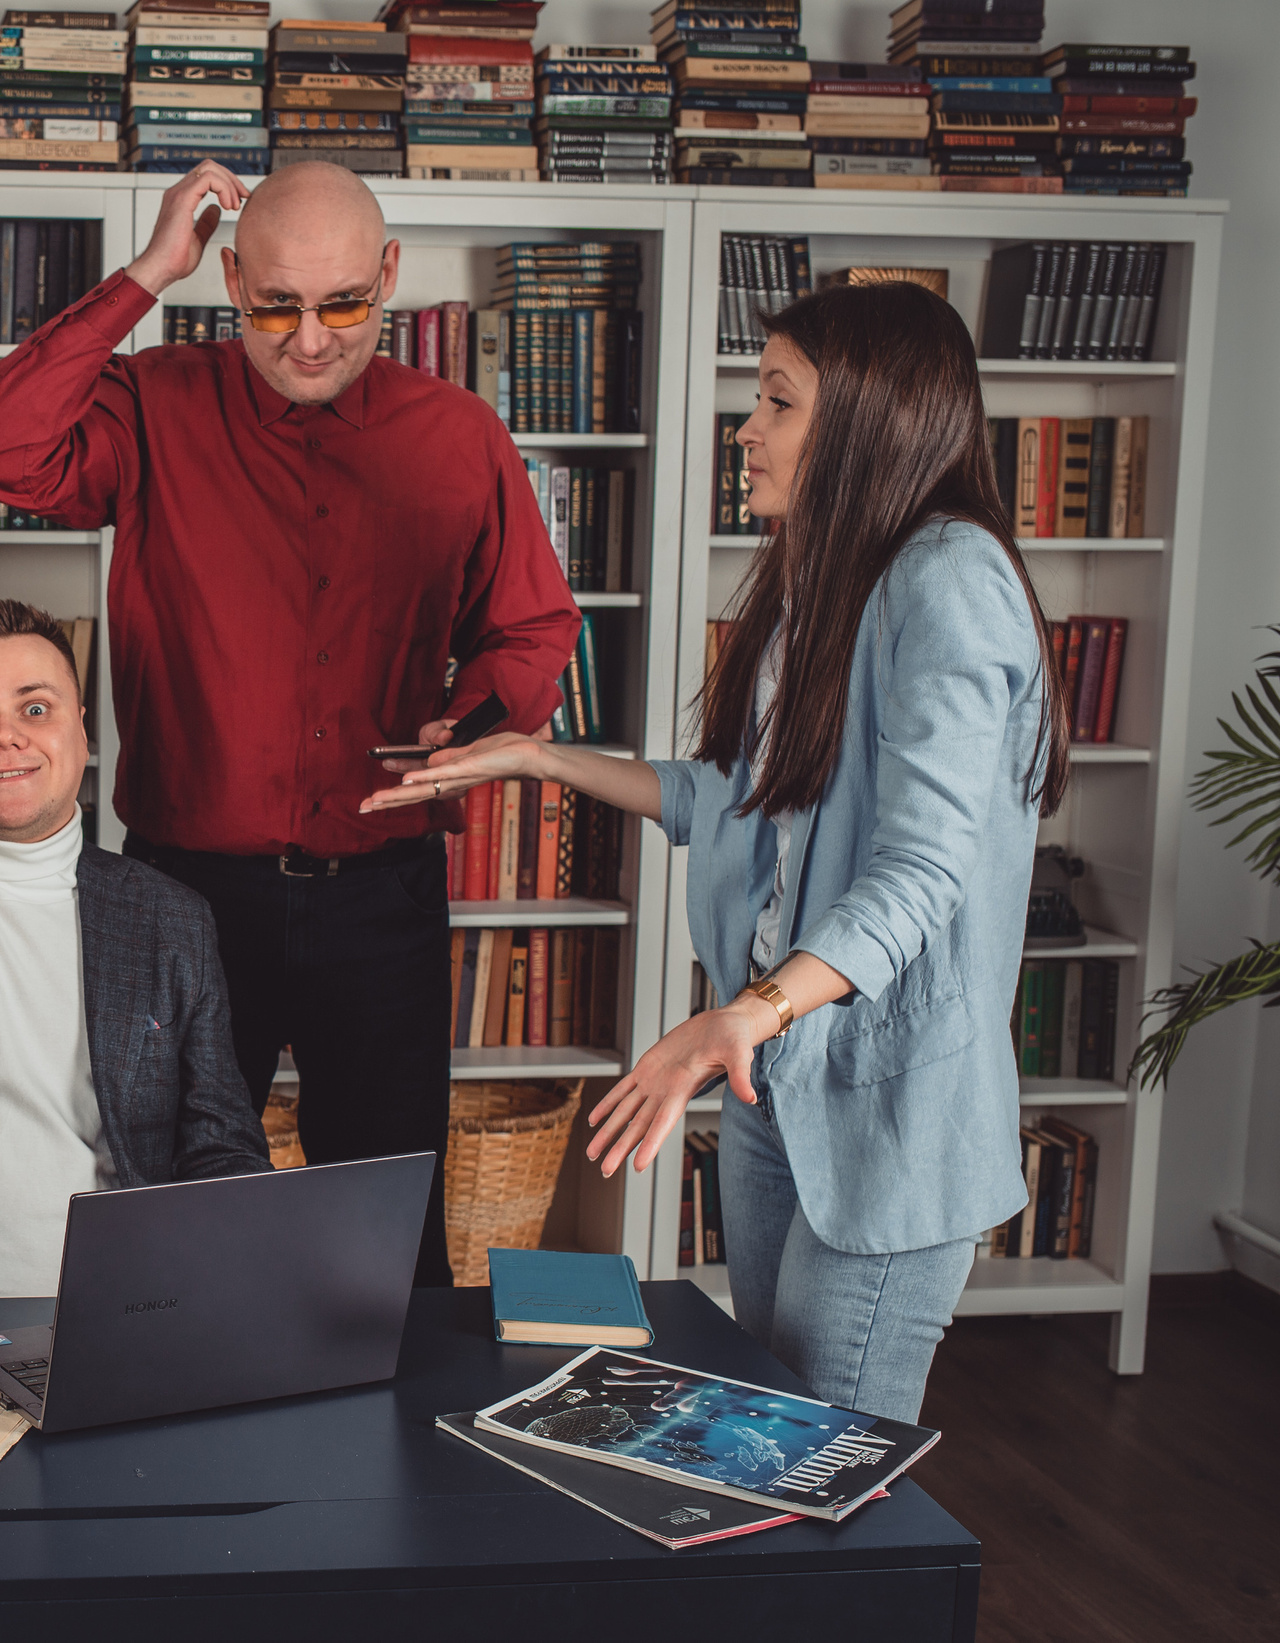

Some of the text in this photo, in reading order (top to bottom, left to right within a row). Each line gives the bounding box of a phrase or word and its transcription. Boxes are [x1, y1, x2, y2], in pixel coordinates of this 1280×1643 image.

[124, 1298, 178, 1315] HONOR
[772, 1423, 896, 1493] Alumni
[670, 1514, 701, 1526] РЭШ
